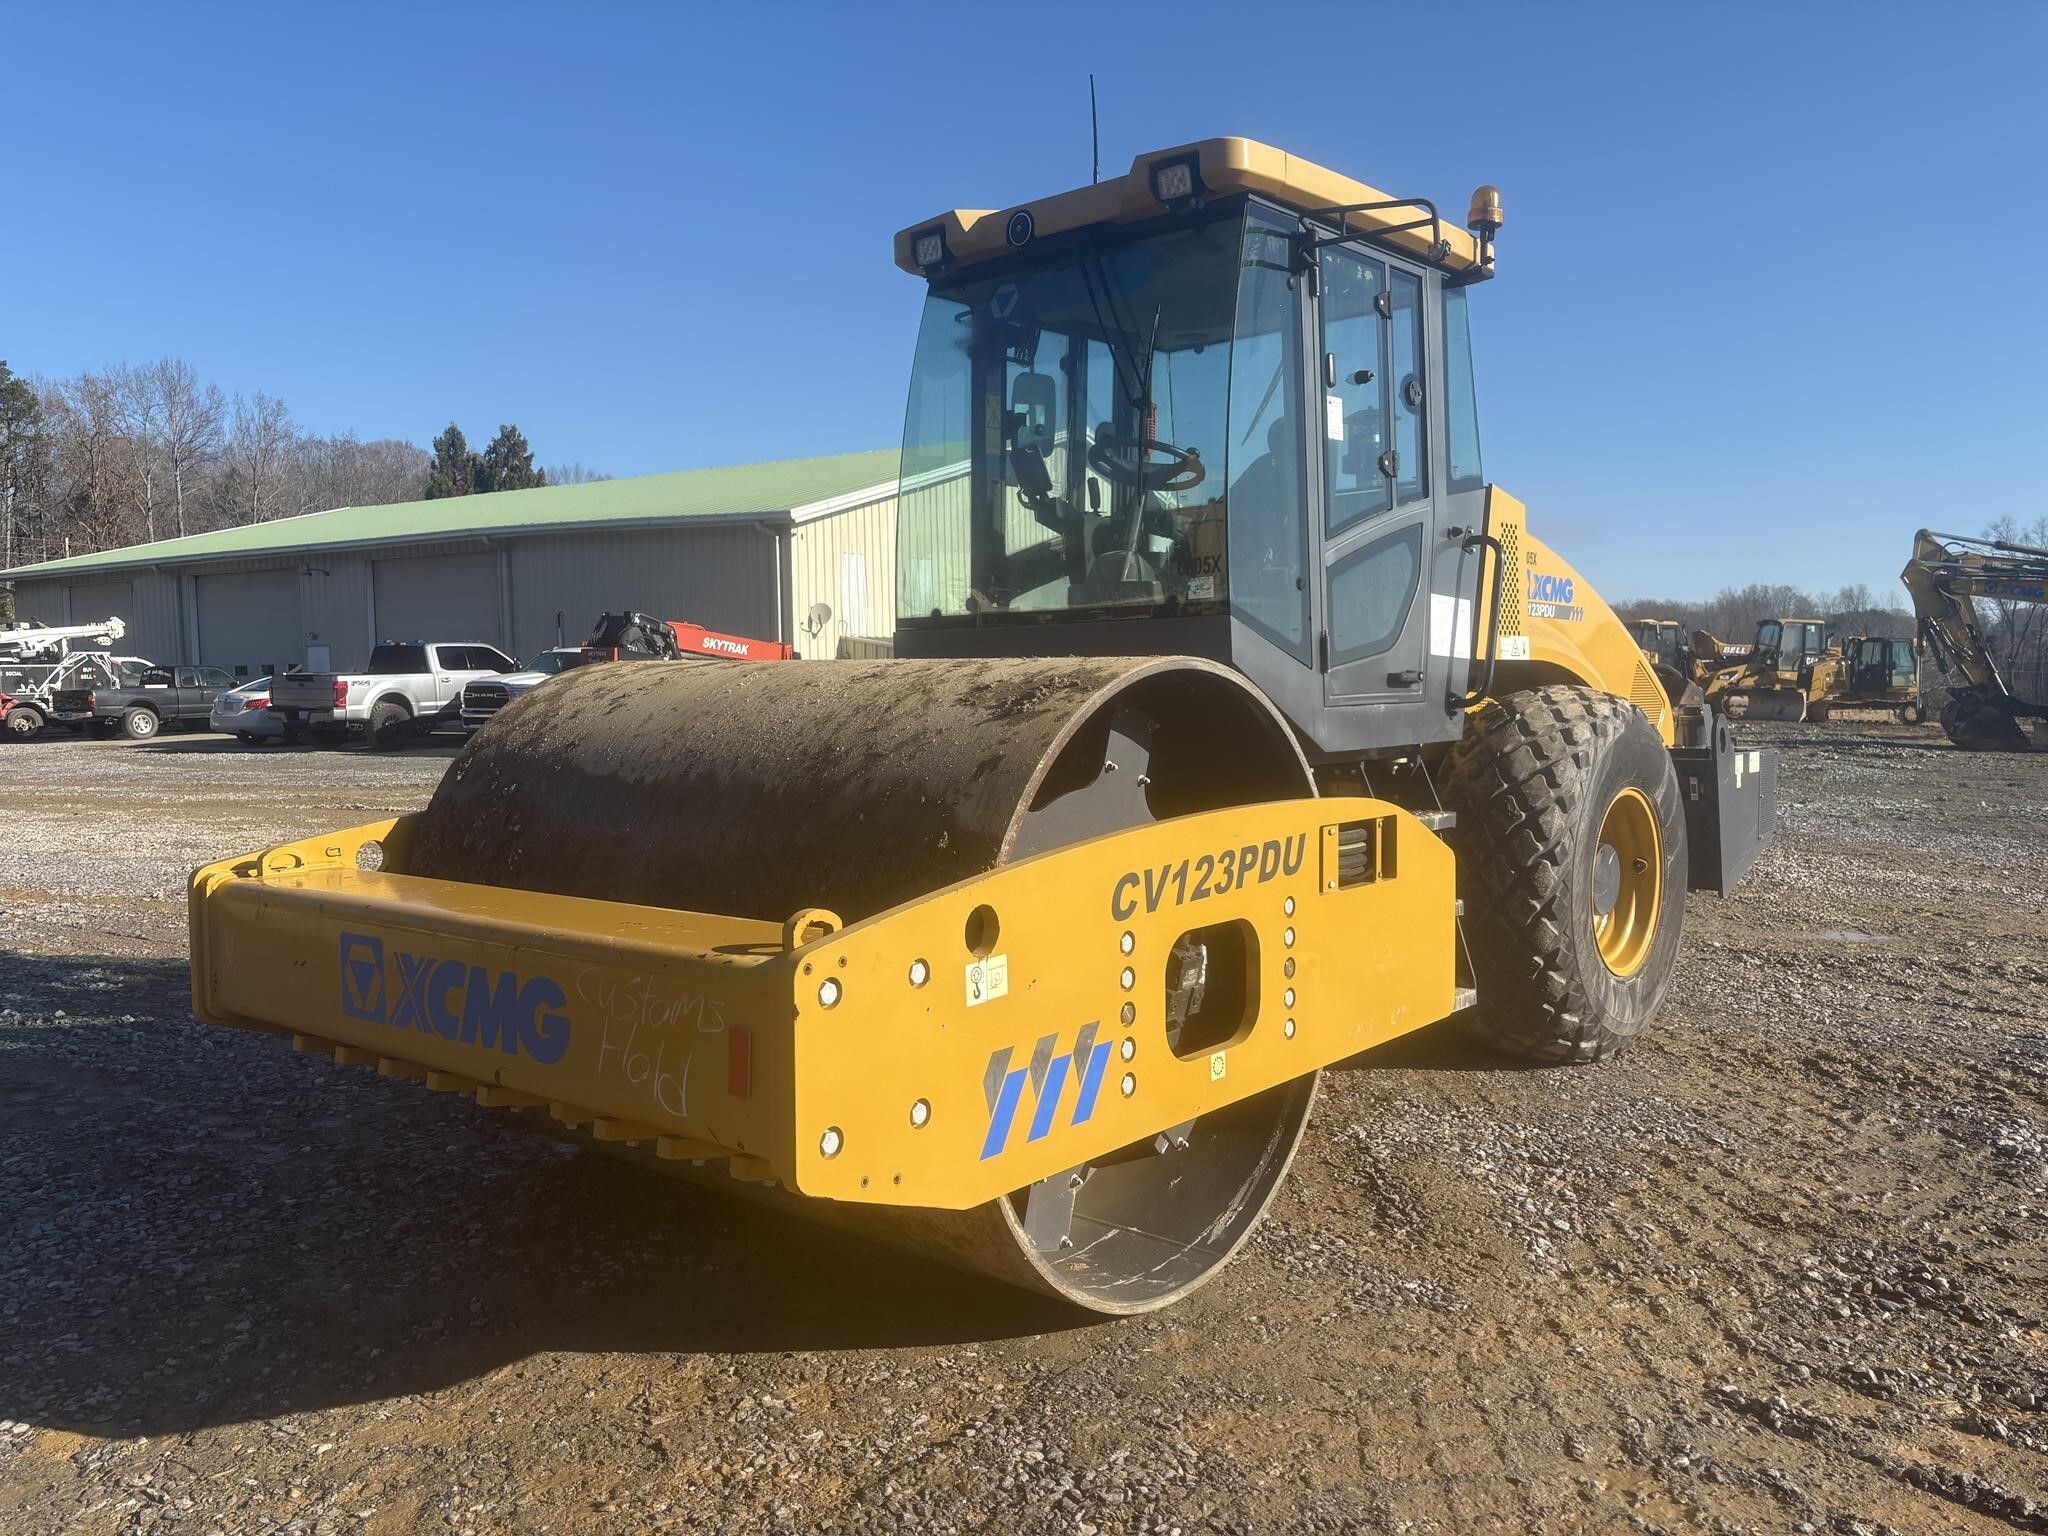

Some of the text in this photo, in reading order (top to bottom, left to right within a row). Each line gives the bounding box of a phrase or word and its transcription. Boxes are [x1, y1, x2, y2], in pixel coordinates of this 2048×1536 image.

[1531, 573, 1574, 604] XCMG
[702, 636, 750, 656] SKYTRAK
[1723, 646, 1746, 654] BELL
[1111, 833, 1307, 922] CV123PDU
[389, 951, 571, 1065] XCMG
